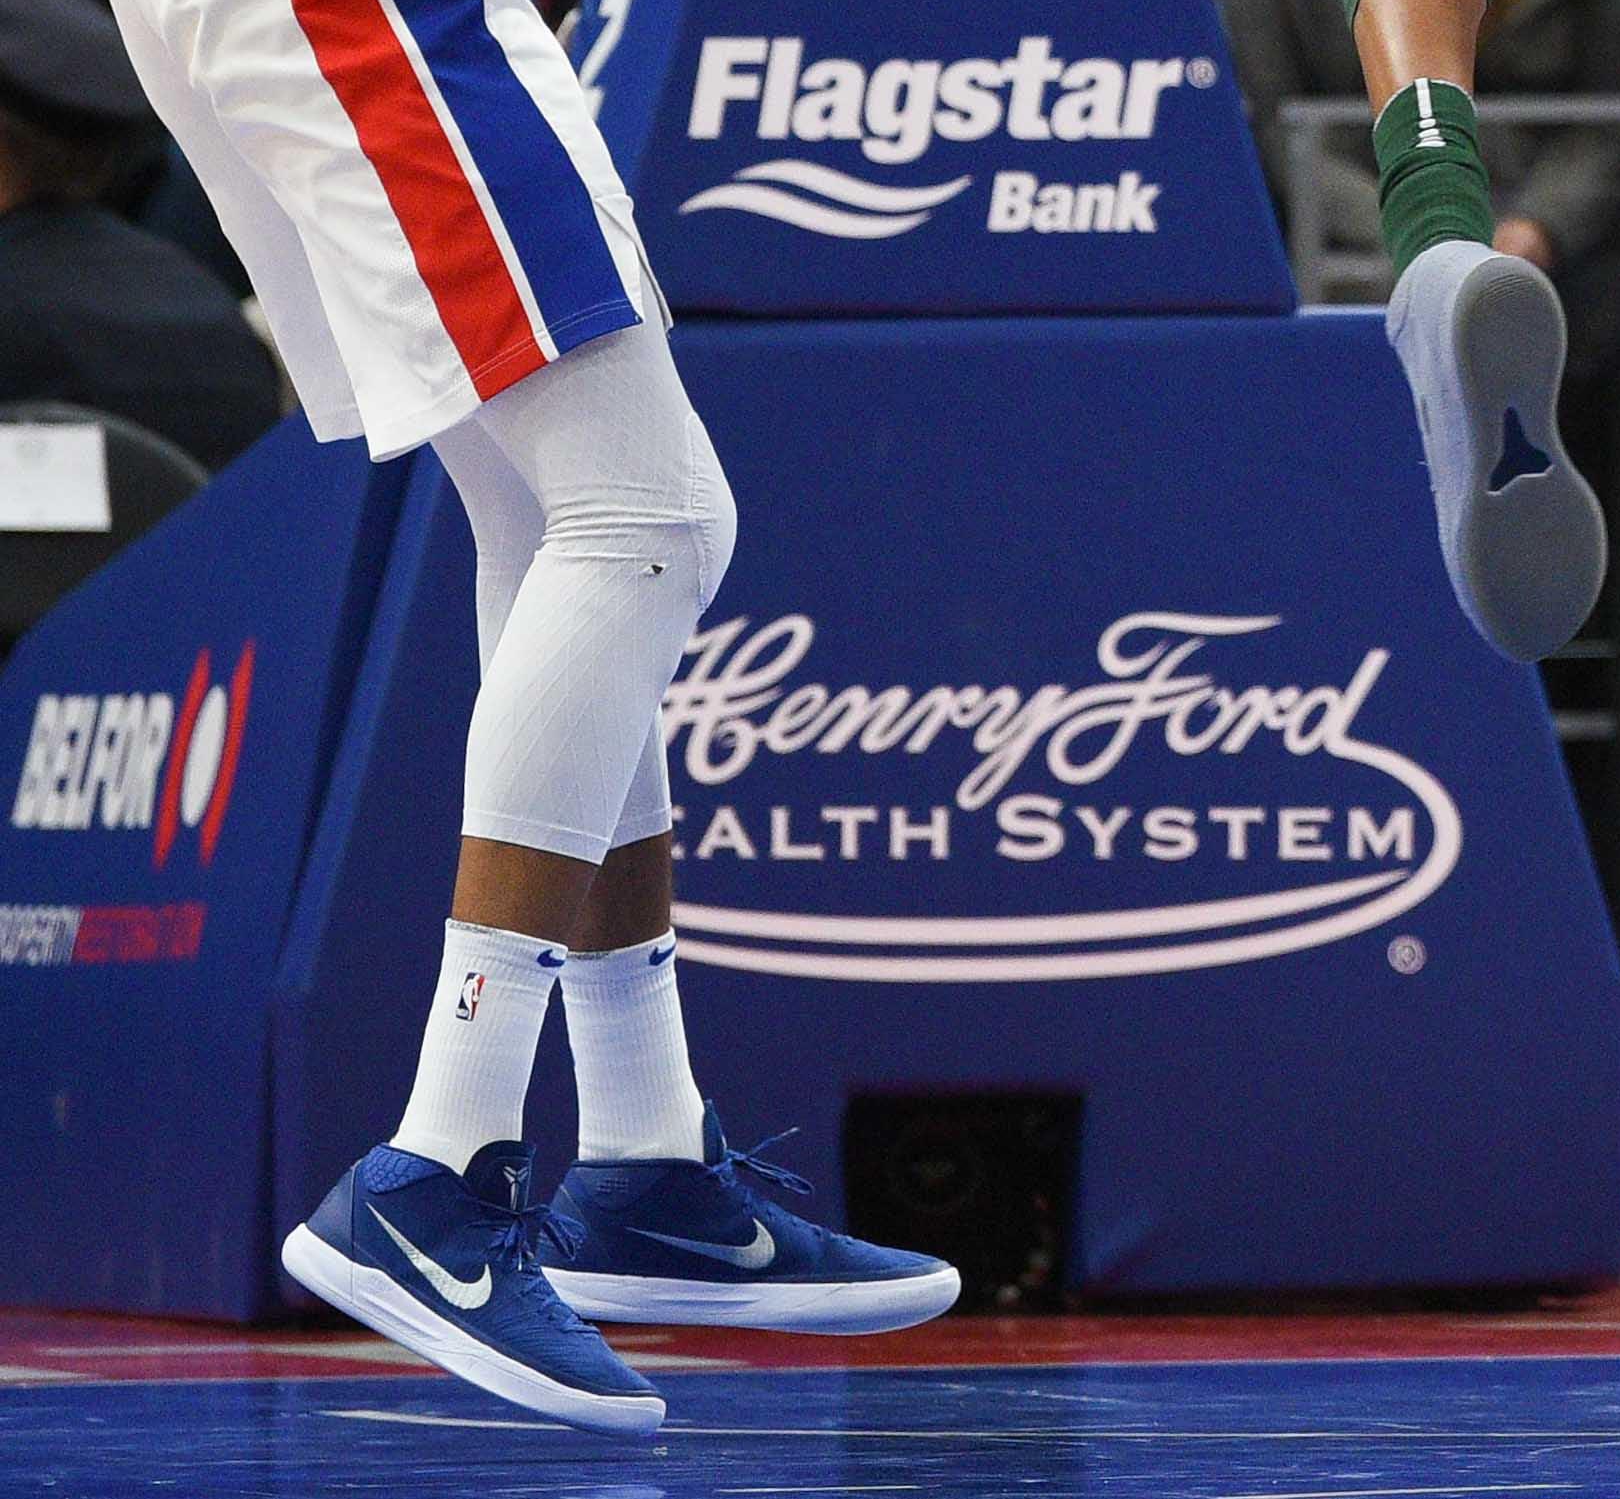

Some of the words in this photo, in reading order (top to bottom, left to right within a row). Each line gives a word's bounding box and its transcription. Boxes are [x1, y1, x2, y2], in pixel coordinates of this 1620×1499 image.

[986, 170, 1161, 235] Bank
[664, 613, 1060, 808] Henry
[1046, 611, 1394, 786] Ford
[669, 805, 950, 862] ALTH
[996, 793, 1415, 862] SYSTEM
